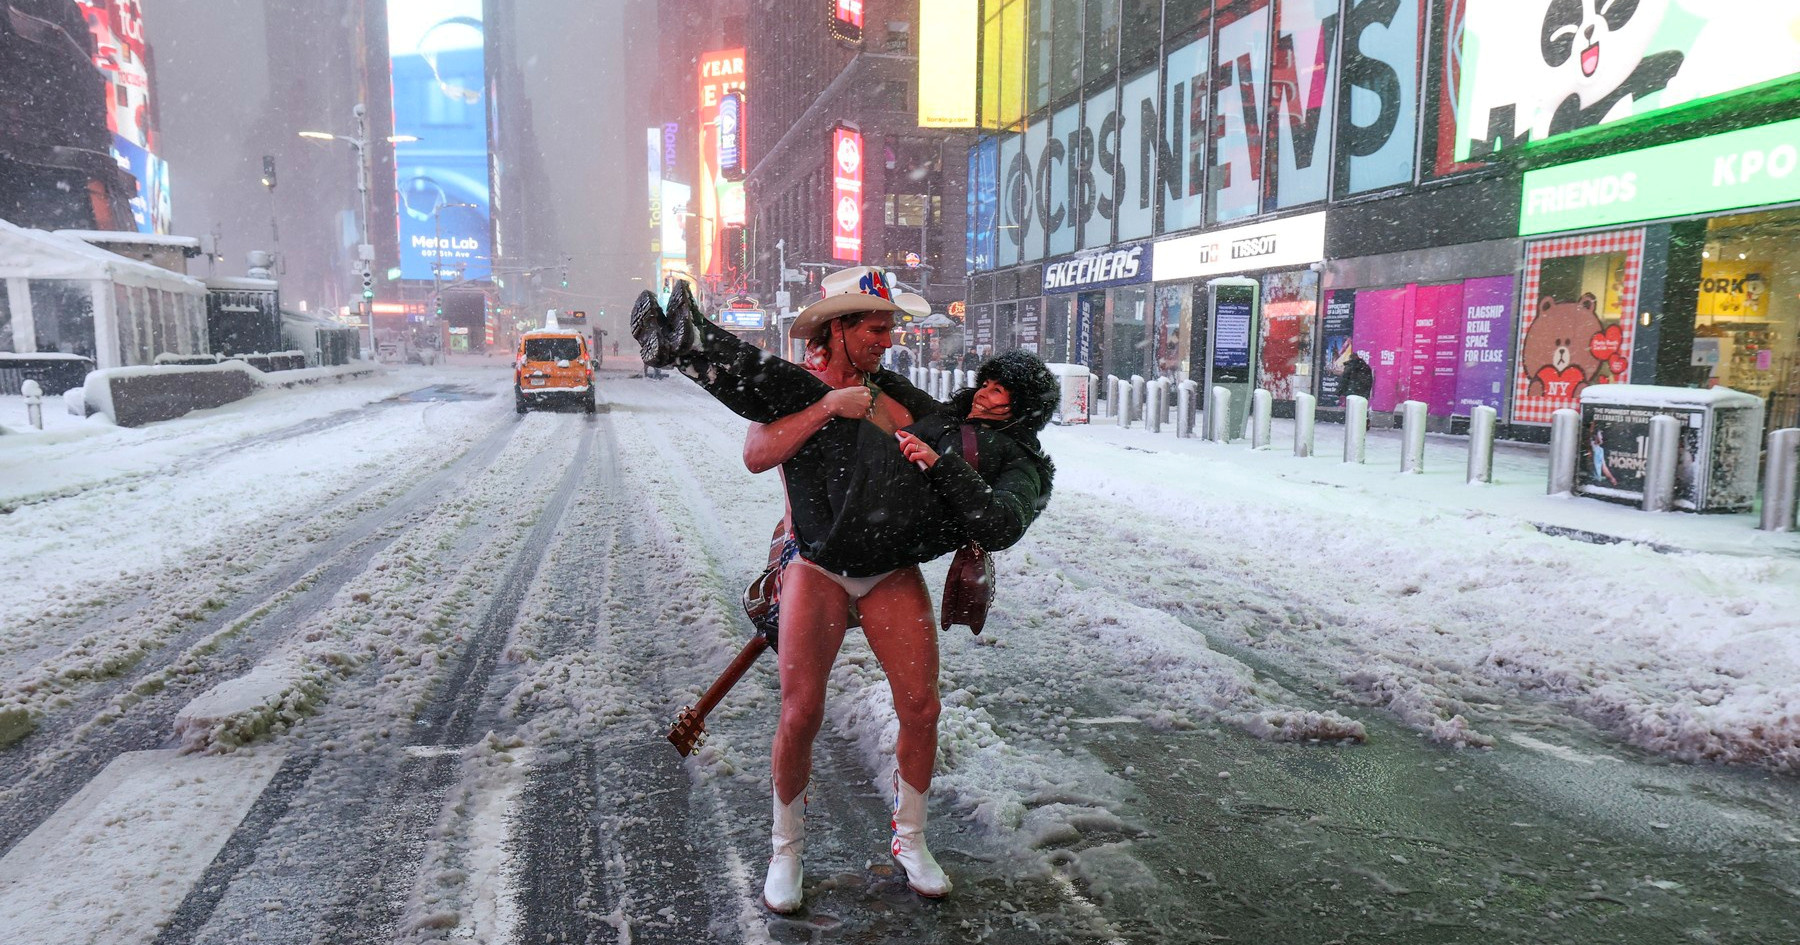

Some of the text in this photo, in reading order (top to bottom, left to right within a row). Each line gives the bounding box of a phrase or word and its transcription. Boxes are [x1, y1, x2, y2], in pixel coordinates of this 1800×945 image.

[702, 58, 744, 78] YEAR
[1036, 0, 1401, 234] CBS NEWS
[1527, 171, 1637, 216] FRIENDS
[411, 235, 479, 250] Meta Lab
[1232, 235, 1277, 258] TISSOT
[454, 250, 470, 258] Ave
[1044, 246, 1144, 289] SKECHERS
[1701, 278, 1746, 293] ORK
[1467, 305, 1504, 319] FLAGSHIP
[1080, 300, 1091, 367] SKECHE
[1466, 320, 1491, 333] RETAIL
[1465, 335, 1489, 347] SPACE
[1464, 350, 1479, 362] FOR
[1480, 349, 1503, 362] LEASE
[1547, 382, 1570, 396] NY
[1593, 414, 1625, 422] CELEBRATES
[1608, 456, 1647, 470] MORMO
